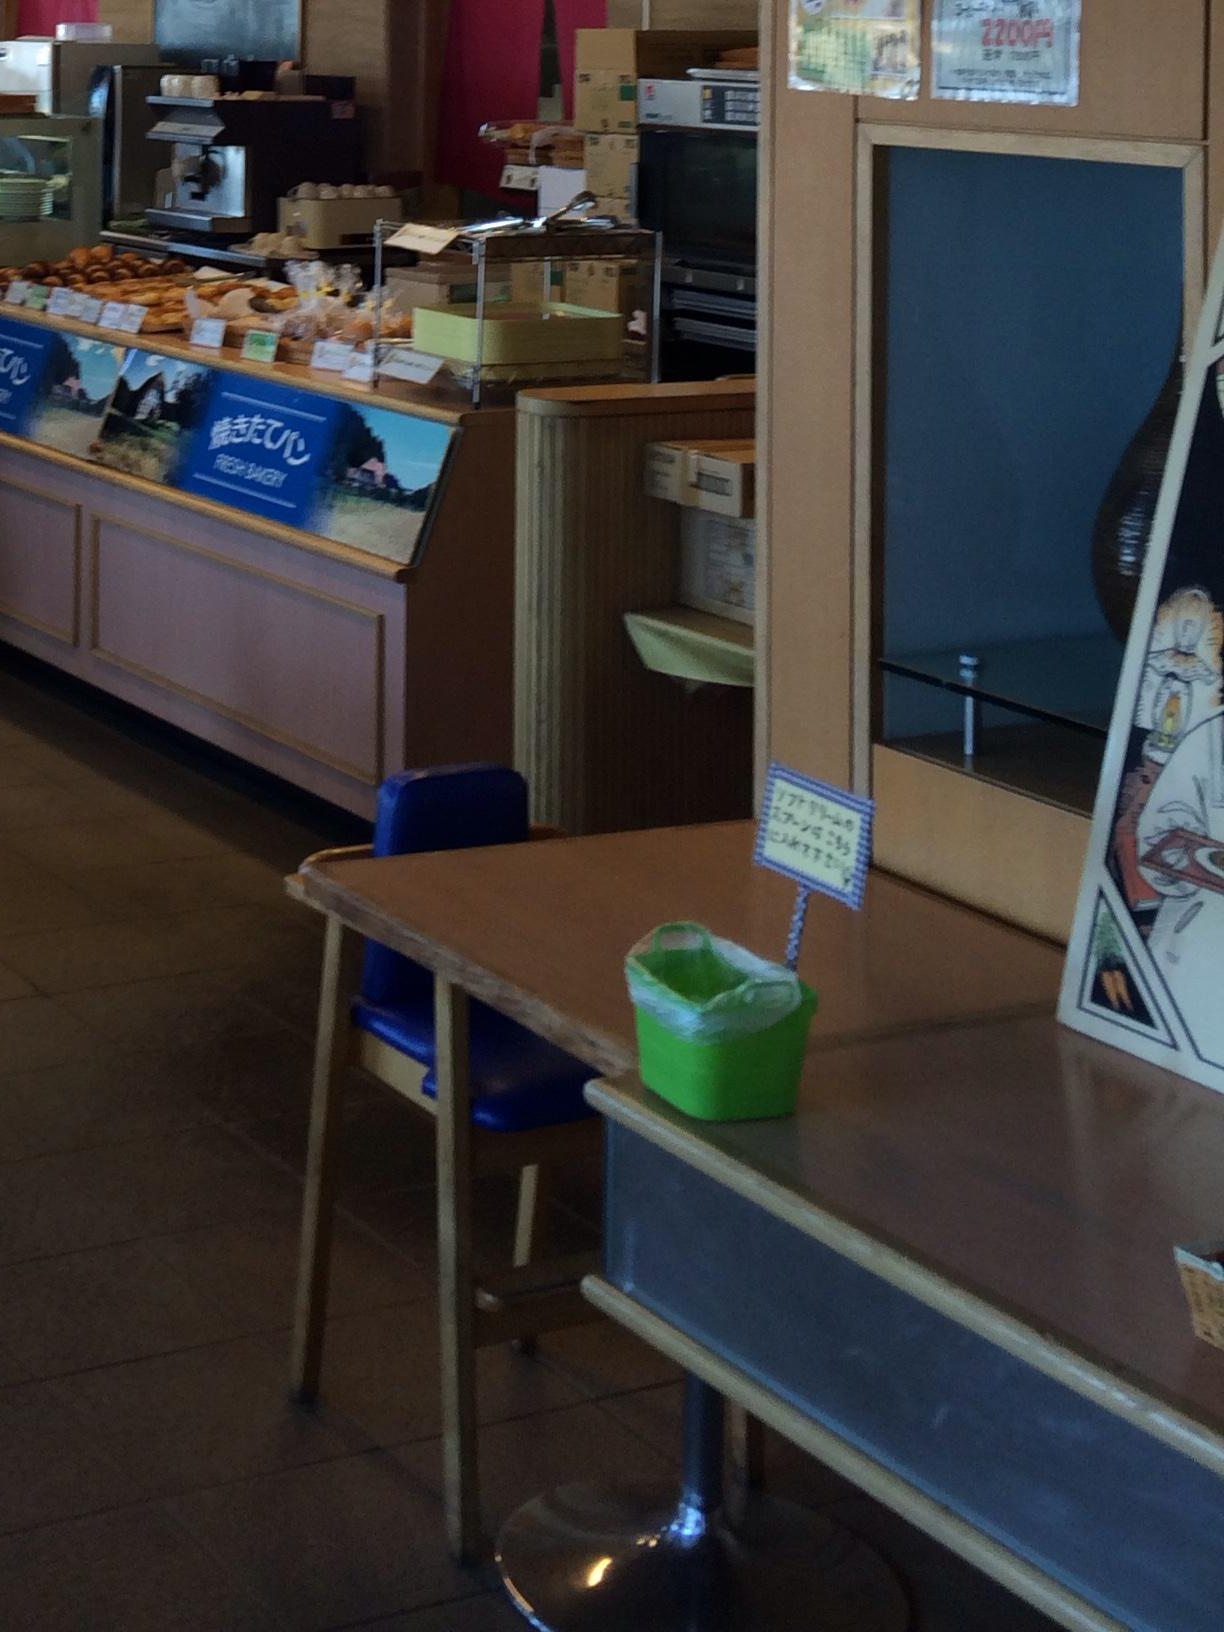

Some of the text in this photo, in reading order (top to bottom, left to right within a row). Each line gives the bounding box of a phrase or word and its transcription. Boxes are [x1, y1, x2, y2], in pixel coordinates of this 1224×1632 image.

[208, 413, 312, 466] 焼きたてパン
